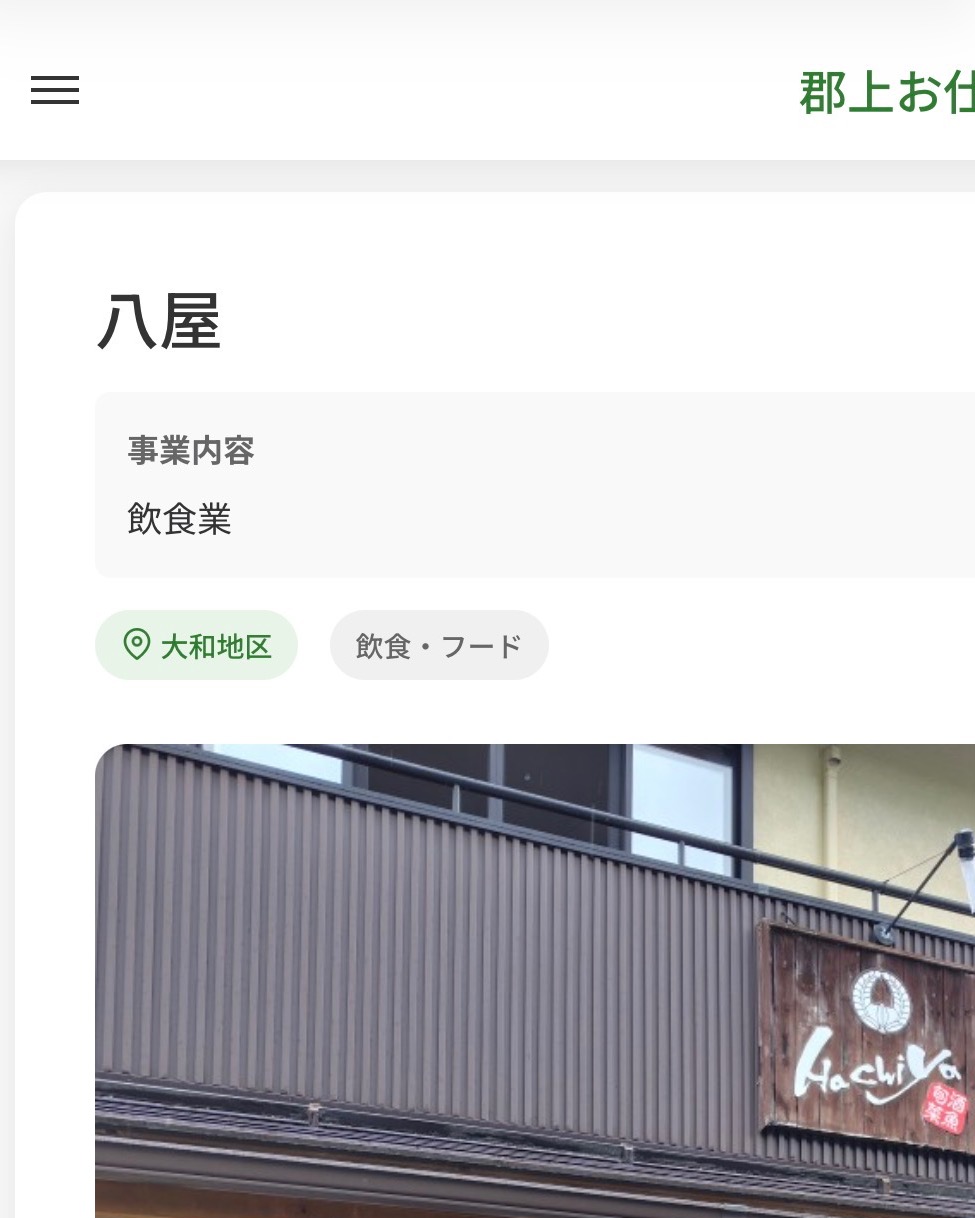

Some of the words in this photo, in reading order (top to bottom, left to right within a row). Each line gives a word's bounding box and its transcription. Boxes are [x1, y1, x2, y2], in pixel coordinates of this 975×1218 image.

[97, 292, 221, 350] 八屋
[127, 434, 255, 466] 事業内容
[127, 501, 232, 536] 飲食業
[161, 632, 272, 660] 大和地区
[355, 632, 521, 660] 飲食・フード
